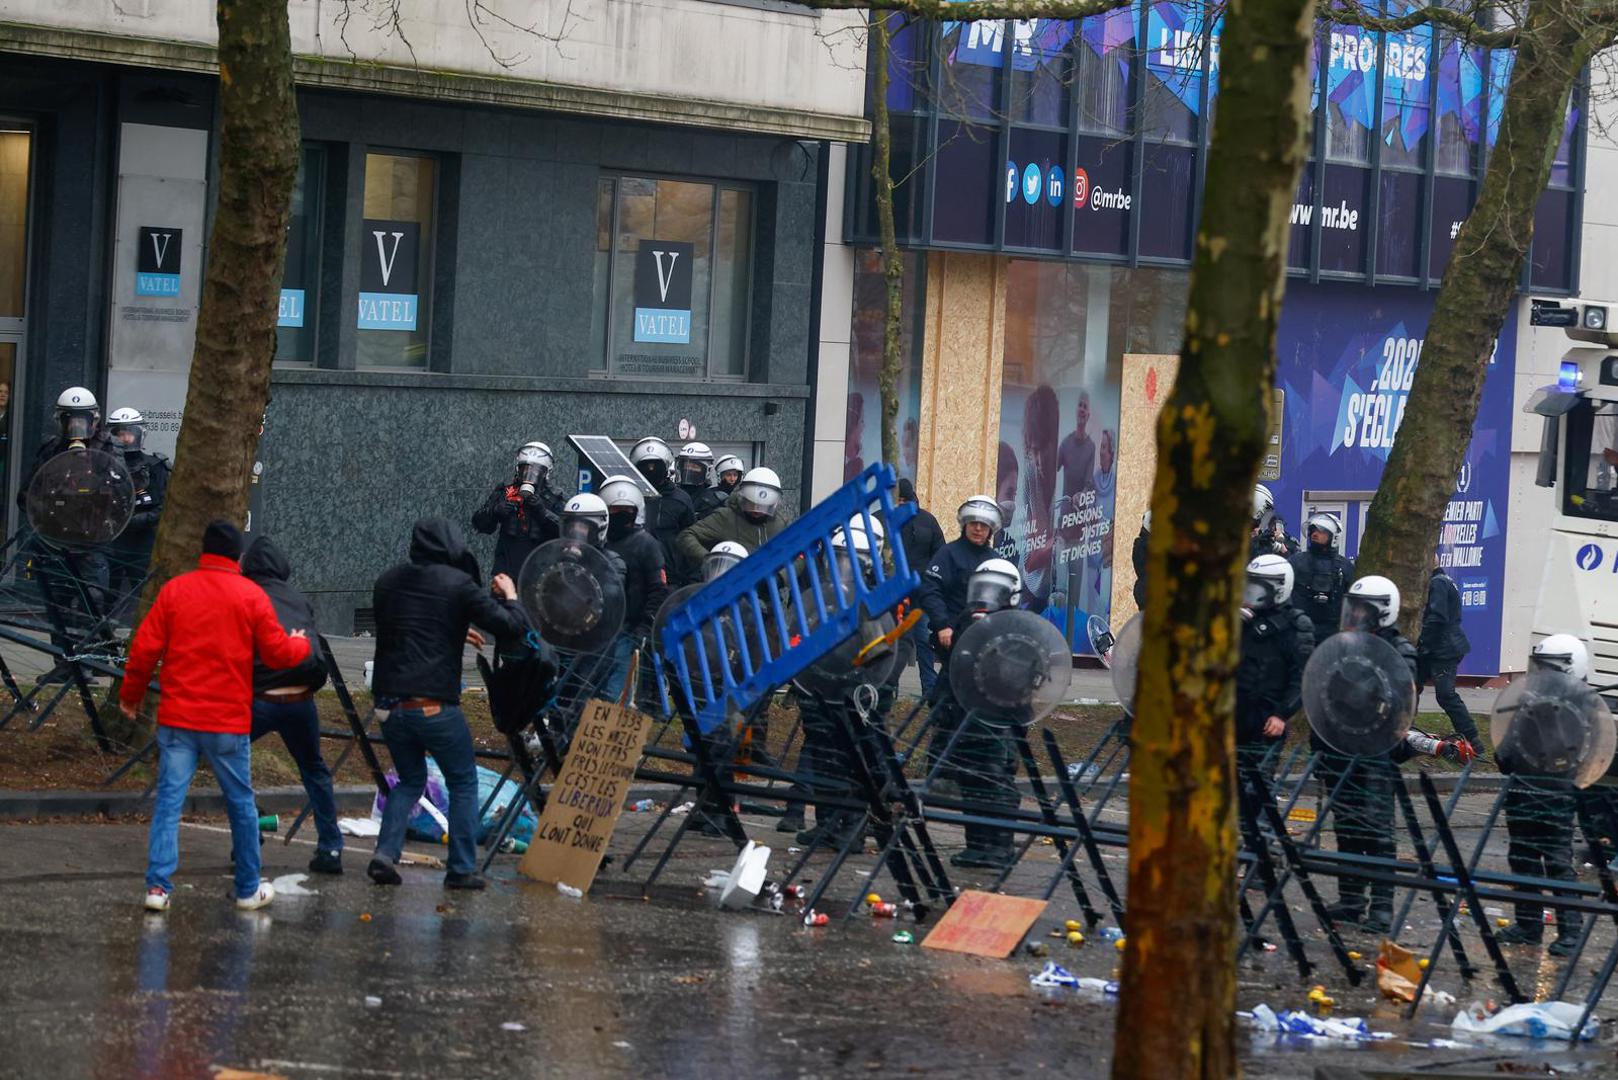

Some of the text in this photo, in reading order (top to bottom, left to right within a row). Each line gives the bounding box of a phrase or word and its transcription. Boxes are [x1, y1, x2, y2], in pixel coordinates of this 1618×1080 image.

[1160, 28, 1220, 72] LIBER
[1329, 32, 1426, 81] PRORÈS
[1091, 185, 1131, 211] @mrbe
[1288, 200, 1358, 230] wwmr.be
[150, 232, 172, 269] V
[373, 231, 404, 286] V
[140, 276, 178, 292] VATEL
[652, 250, 680, 302] V
[359, 298, 413, 322] VATEL
[639, 314, 688, 336] VATEL
[1379, 337, 1424, 391] 202
[140, 410, 183, 420] el-brussels.b
[579, 469, 591, 490] P
[1079, 490, 1096, 507] DES
[1061, 505, 1104, 528] PENSIONS
[1443, 501, 1483, 521] EMIER PARTI
[1004, 519, 1038, 541] TAIL
[1080, 519, 1110, 541] JUSTES
[1443, 524, 1477, 544] BRUXELLES
[994, 529, 1047, 559] ÉCOENSÉ
[1060, 540, 1102, 563] ET DIGNES
[1452, 547, 1483, 566] WALLONIE
[593, 707, 610, 721] EN
[583, 724, 605, 740] LES
[570, 754, 597, 774] PRIS
[573, 815, 594, 832] QUI
